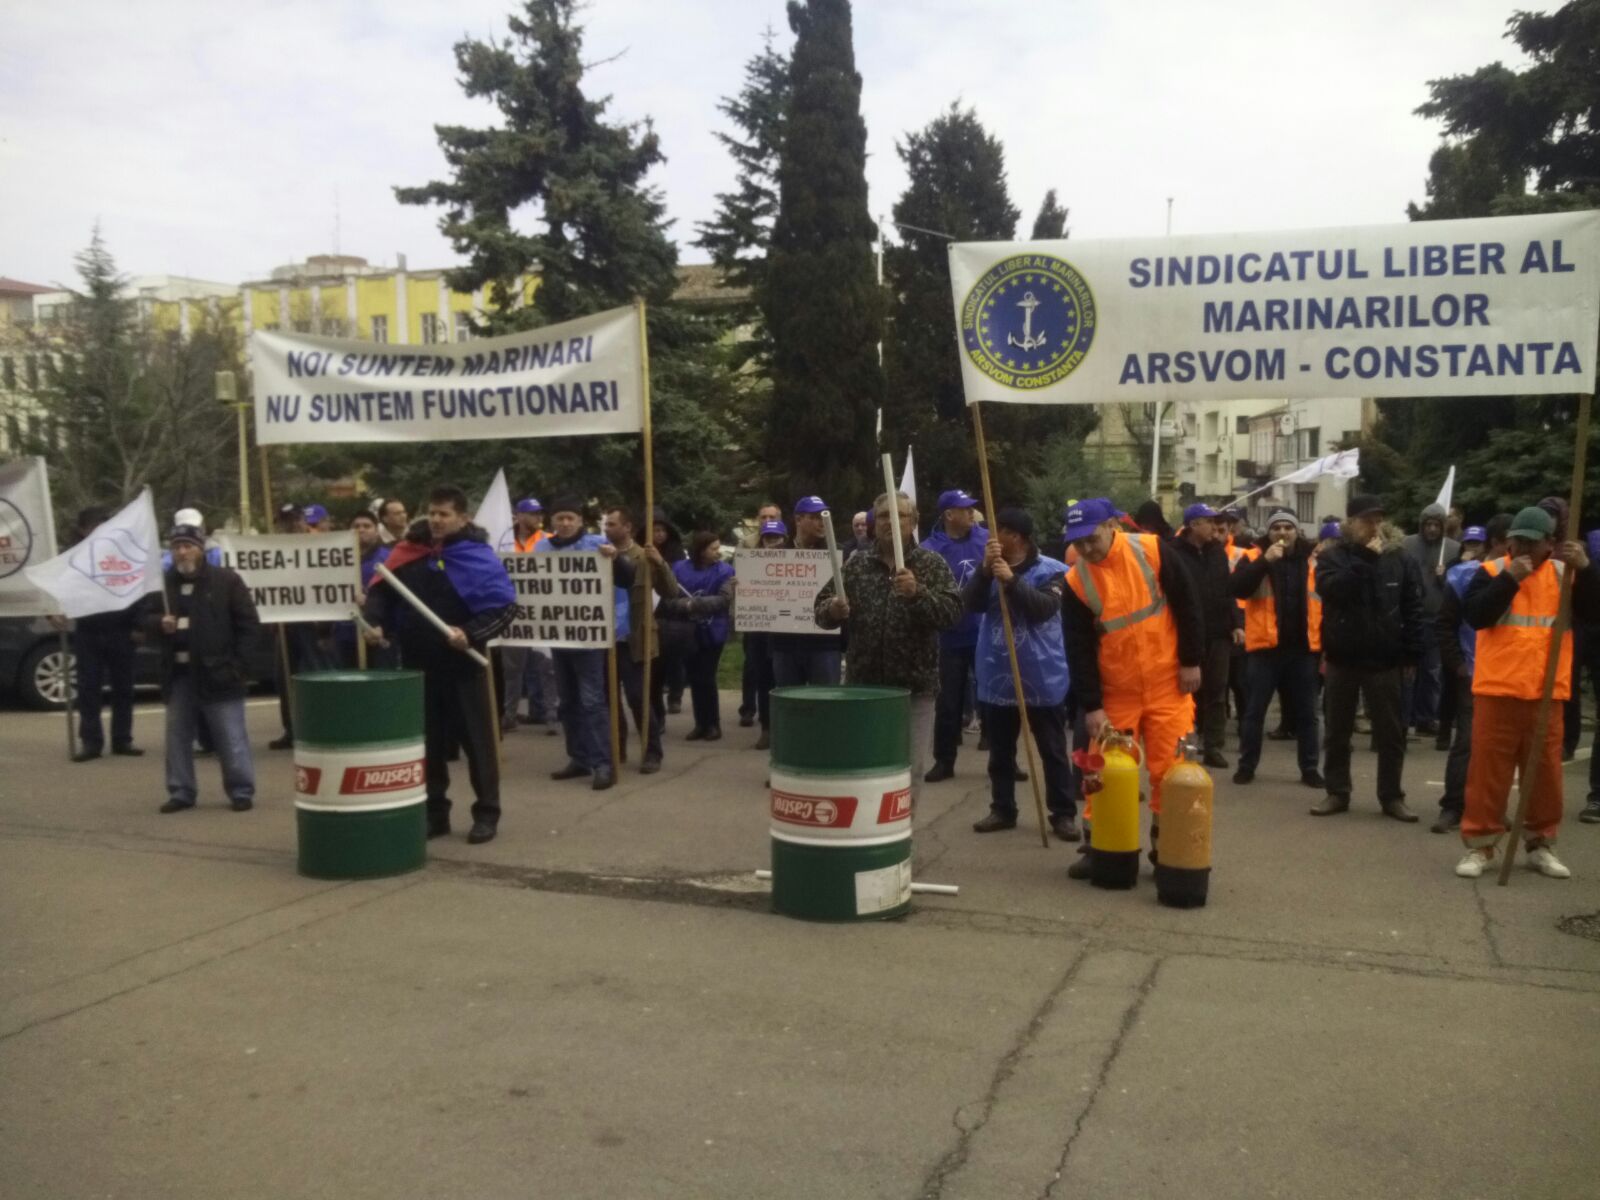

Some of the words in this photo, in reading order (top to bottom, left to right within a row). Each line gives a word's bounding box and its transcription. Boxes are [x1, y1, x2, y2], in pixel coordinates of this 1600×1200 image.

[1129, 249, 1368, 288] SINDICATUL
[1384, 242, 1506, 278] LIBER
[1520, 240, 1575, 273] AL
[964, 274, 998, 329] SINDICATUL
[999, 257, 1031, 275] LIBER
[1034, 257, 1047, 267] AL
[1050, 260, 1093, 328] MARINARILOR
[1203, 293, 1490, 333] MARINARILOR
[287, 351, 332, 377] NOI
[338, 353, 455, 376] SUNTEM
[461, 335, 593, 376] MARINARI
[1119, 348, 1286, 384] ARSVOM
[1325, 342, 1582, 379] CONSTANTA
[970, 349, 1013, 385] ARSVOM
[1016, 350, 1084, 387] CONSTANTA
[266, 395, 300, 423] NU
[309, 391, 414, 422] SUNTEM
[422, 380, 619, 419] FUNCTIONARI
[307, 547, 355, 568] LEGE
[558, 557, 598, 573] UNA
[765, 563, 816, 577] CEREM
[250, 585, 305, 606] NTRU
[312, 584, 355, 604] TOTI
[558, 578, 602, 594] TOTI
[541, 606, 605, 621] APLICA
[539, 626, 559, 640] LA
[564, 626, 607, 641] HOTI
[364, 767, 412, 787] Castrol
